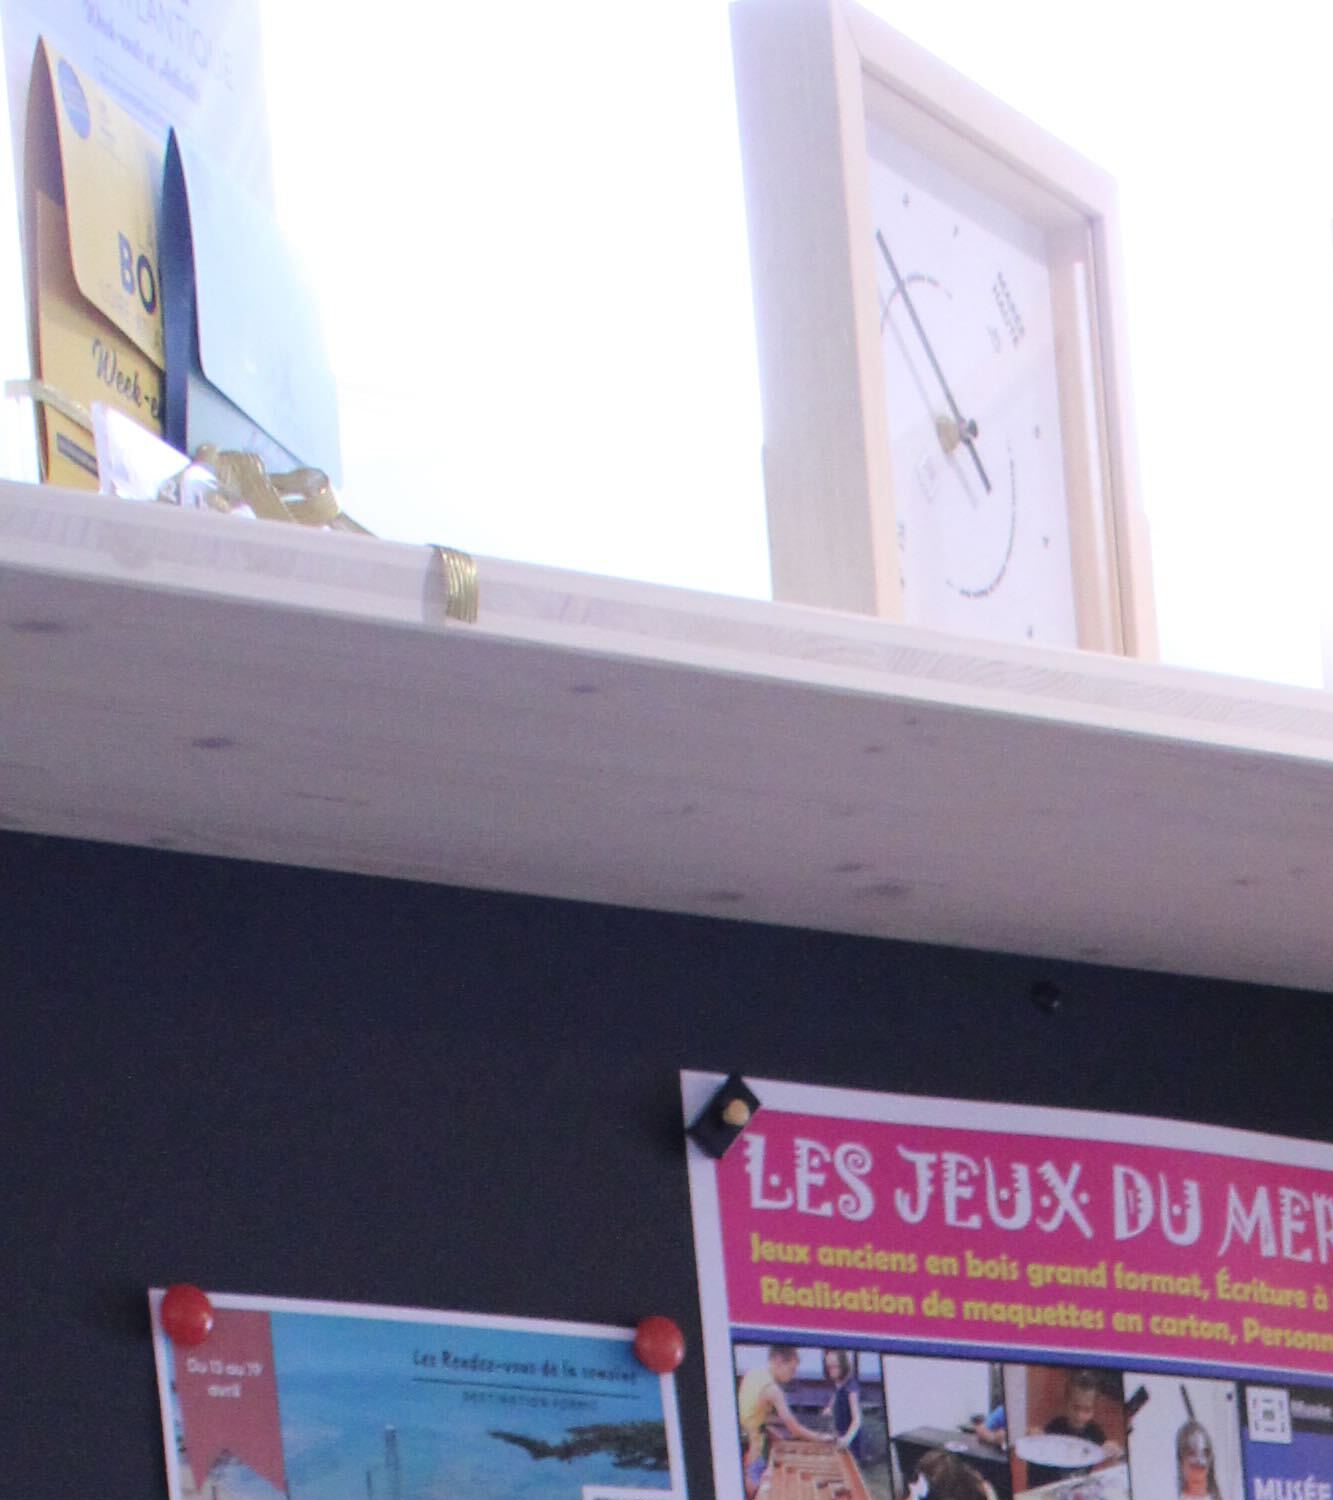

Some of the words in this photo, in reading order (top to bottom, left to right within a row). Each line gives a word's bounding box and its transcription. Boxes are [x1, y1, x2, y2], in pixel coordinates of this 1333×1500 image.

[743, 1133, 875, 1221] LES
[894, 1145, 1094, 1239] JEUX
[1112, 1163, 1202, 1246] DU
[751, 1232, 809, 1262] Jeux
[819, 1243, 917, 1273] anciens
[926, 1257, 957, 1275] en
[965, 1250, 1018, 1280] bois
[1028, 1261, 1106, 1288] grand
[1113, 1262, 1211, 1300] format,
[1217, 1267, 1306, 1308] Écriture
[1313, 1286, 1327, 1310] à
[760, 1276, 913, 1316] Réalisation
[923, 1292, 954, 1318] de
[963, 1297, 1104, 1329] maquettes
[1113, 1309, 1142, 1332] en
[1150, 1312, 1237, 1343] carton,
